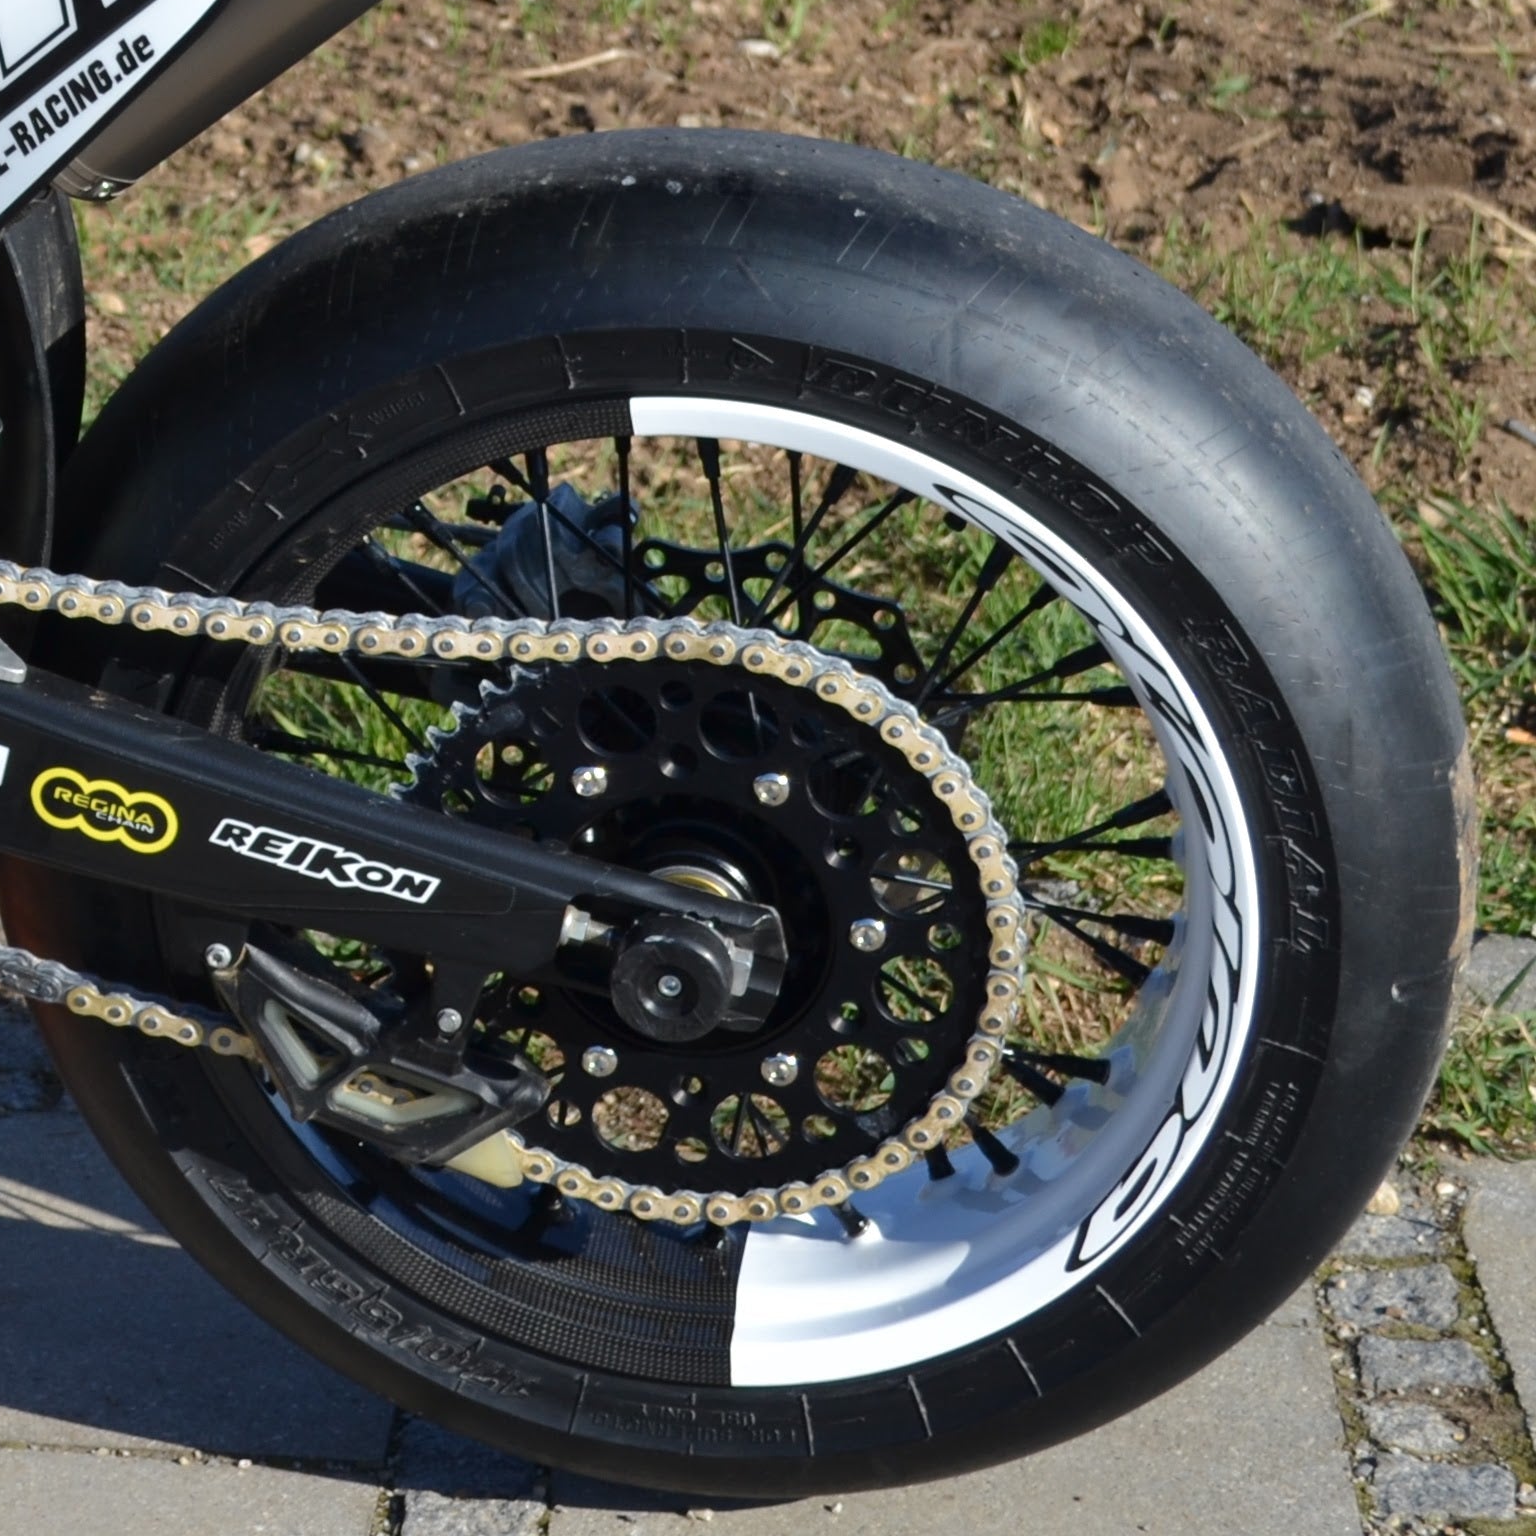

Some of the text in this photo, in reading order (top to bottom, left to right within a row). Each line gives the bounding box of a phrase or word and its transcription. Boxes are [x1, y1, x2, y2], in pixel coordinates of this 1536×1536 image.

[52, 786, 154, 827] REGINA
[95, 809, 154, 835] CHAIN
[1182, 617, 1328, 954] RADIAL
[212, 819, 439, 903] REIKON
[932, 483, 1244, 1274] alpina
